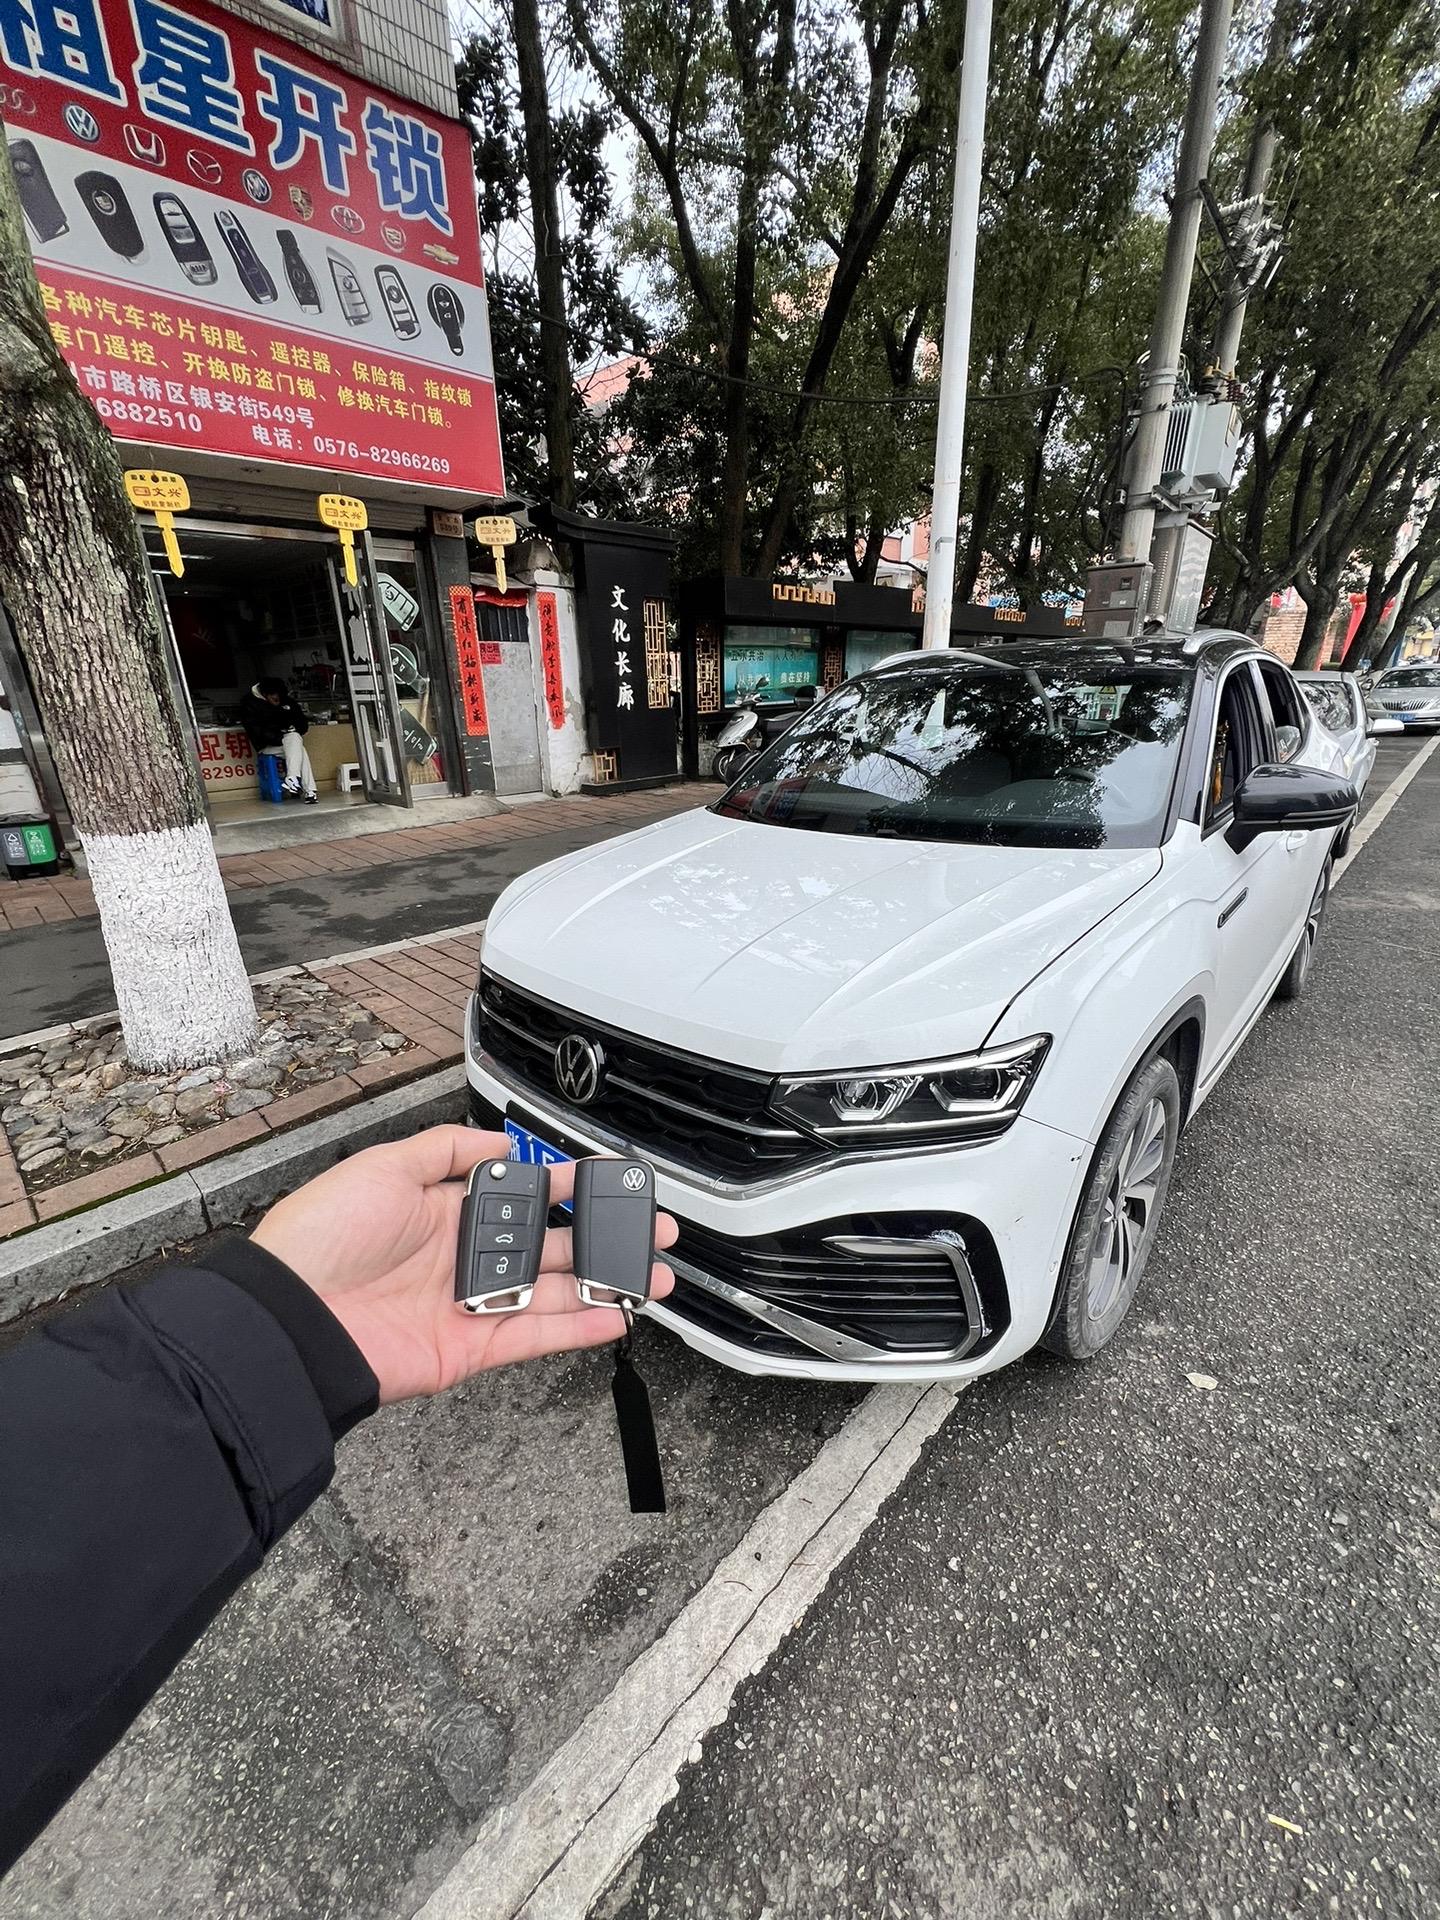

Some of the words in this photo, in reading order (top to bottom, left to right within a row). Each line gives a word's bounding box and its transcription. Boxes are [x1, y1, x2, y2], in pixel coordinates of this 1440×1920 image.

[93, 396, 203, 433] 6882510
[610, 585, 635, 711] 文化长廊
